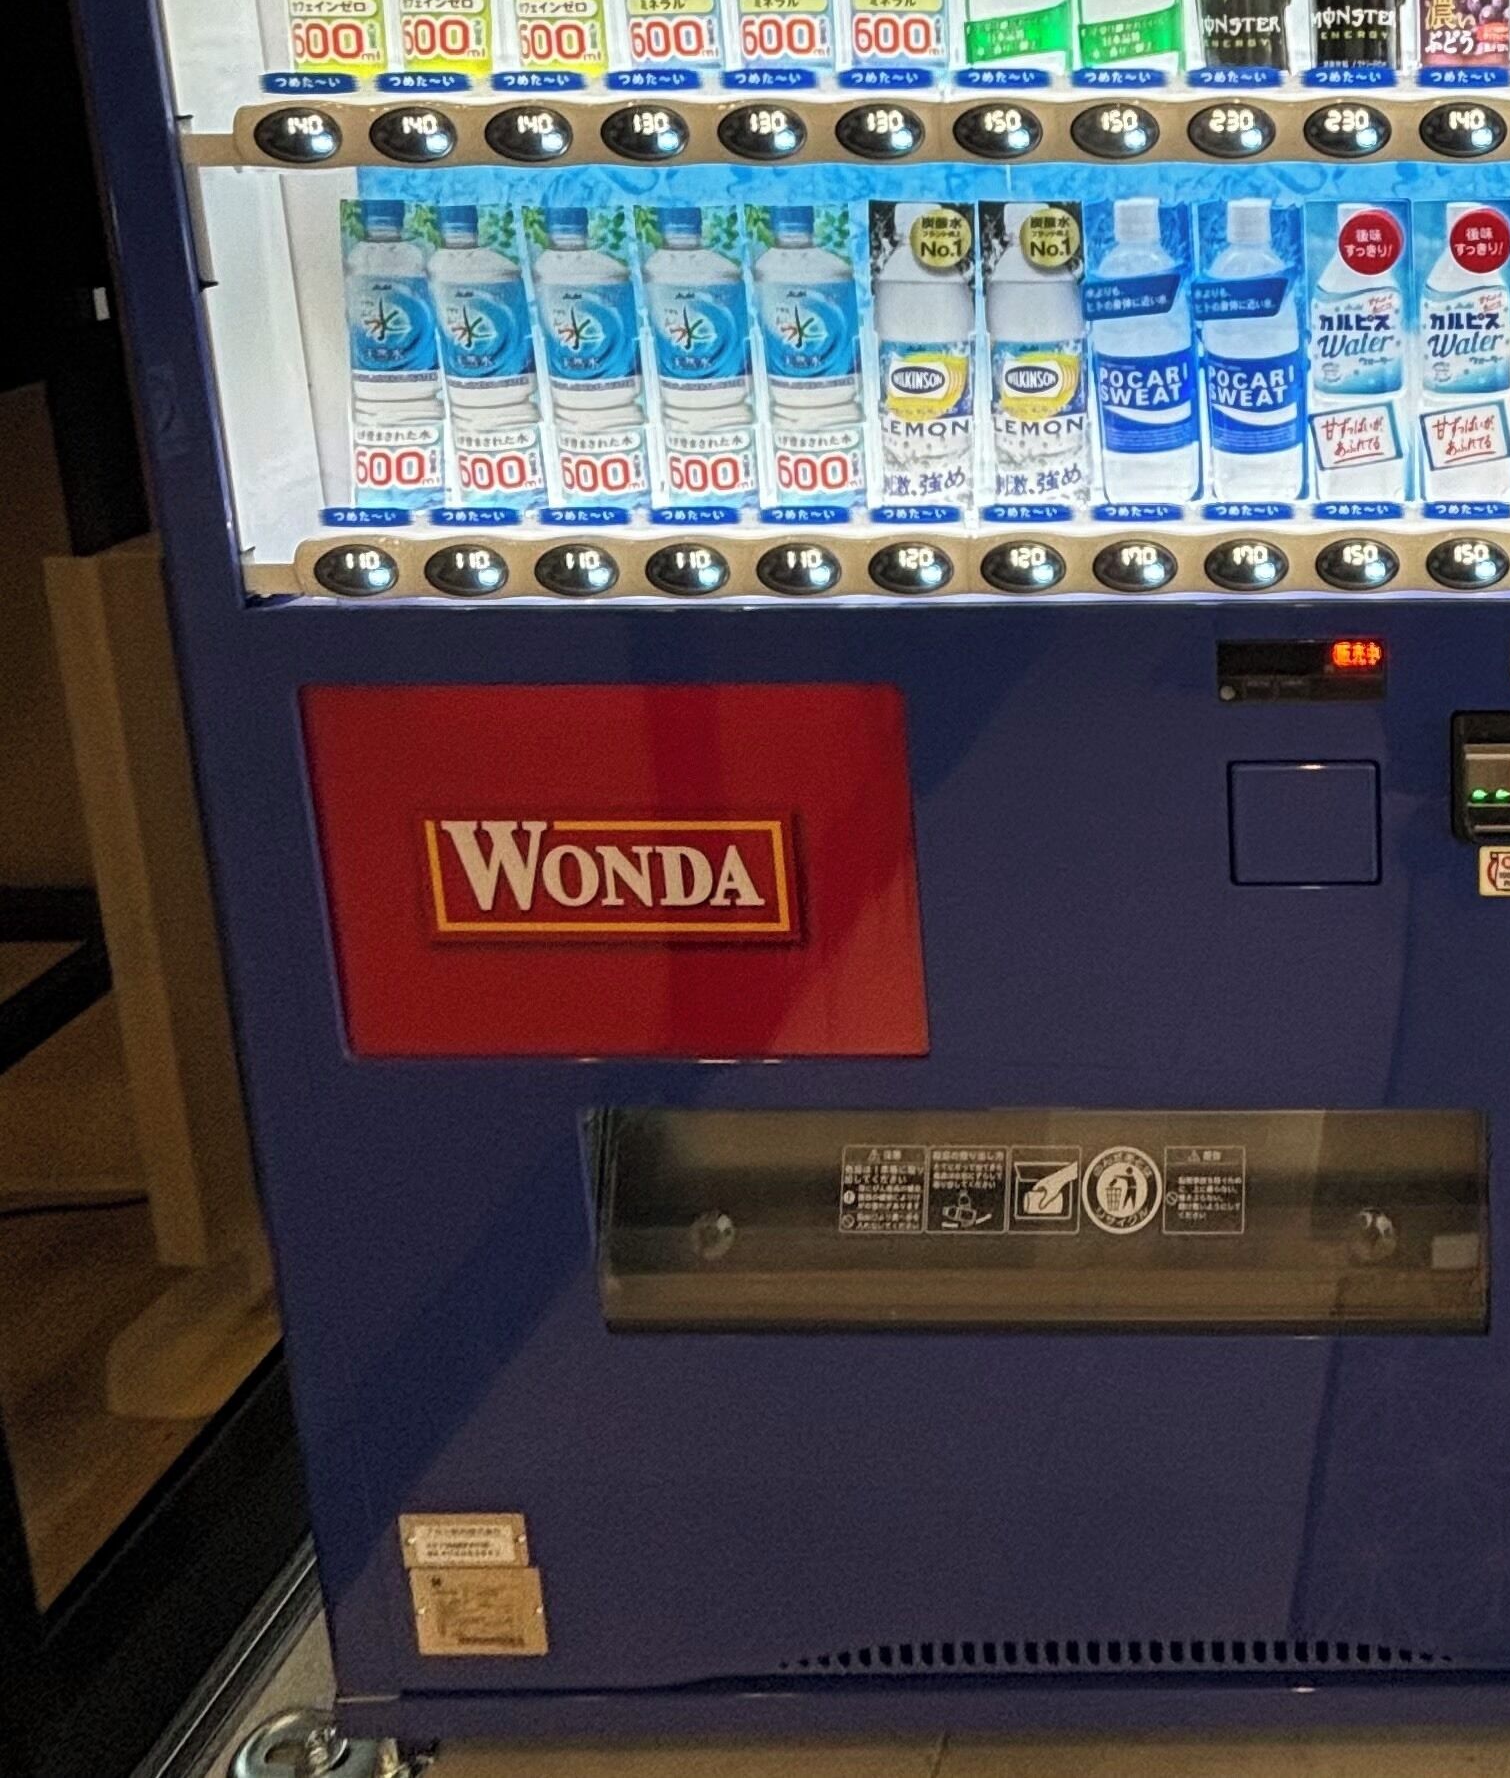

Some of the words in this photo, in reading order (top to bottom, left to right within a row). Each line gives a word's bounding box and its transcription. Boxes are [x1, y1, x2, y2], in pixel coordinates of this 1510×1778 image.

[1424, 30, 1474, 55] ぶどう
[288, 114, 323, 135] 140
[402, 114, 437, 135] 140
[517, 113, 553, 135] 140
[633, 112, 669, 134] 130
[750, 110, 787, 134] 130
[866, 109, 904, 133] 130
[985, 109, 1022, 133] 150
[1101, 108, 1139, 133] 150
[1209, 108, 1254, 133] 230
[1323, 108, 1369, 133] 230
[1449, 109, 1485, 131] 140
[921, 216, 962, 230] 炭酸水
[1030, 216, 1070, 229] 炭酸水
[920, 240, 962, 258] No.1
[1030, 239, 1071, 258] No.1
[1319, 313, 1391, 332] カルピス
[1430, 312, 1501, 331] カルピス
[1317, 332, 1394, 358] Water
[1427, 331, 1504, 358] Water
[893, 370, 943, 389] WILKINSON
[1006, 370, 1057, 389] WILKINSON
[1100, 362, 1188, 390] POCARI
[1208, 364, 1294, 390] POCARI
[1100, 383, 1182, 406] SWEAT
[1208, 383, 1288, 407] SWEAT
[881, 419, 970, 438] LEMON
[993, 417, 1084, 436] LEMON
[345, 551, 381, 570] 110
[455, 550, 491, 570] 110
[565, 550, 600, 571] 110
[676, 549, 711, 569] 110
[786, 548, 822, 569] 110
[898, 547, 934, 569] 120
[1009, 547, 1047, 569] 120
[1343, 544, 1379, 565] 150
[1453, 544, 1490, 565] 150
[440, 821, 765, 911] WONDA
